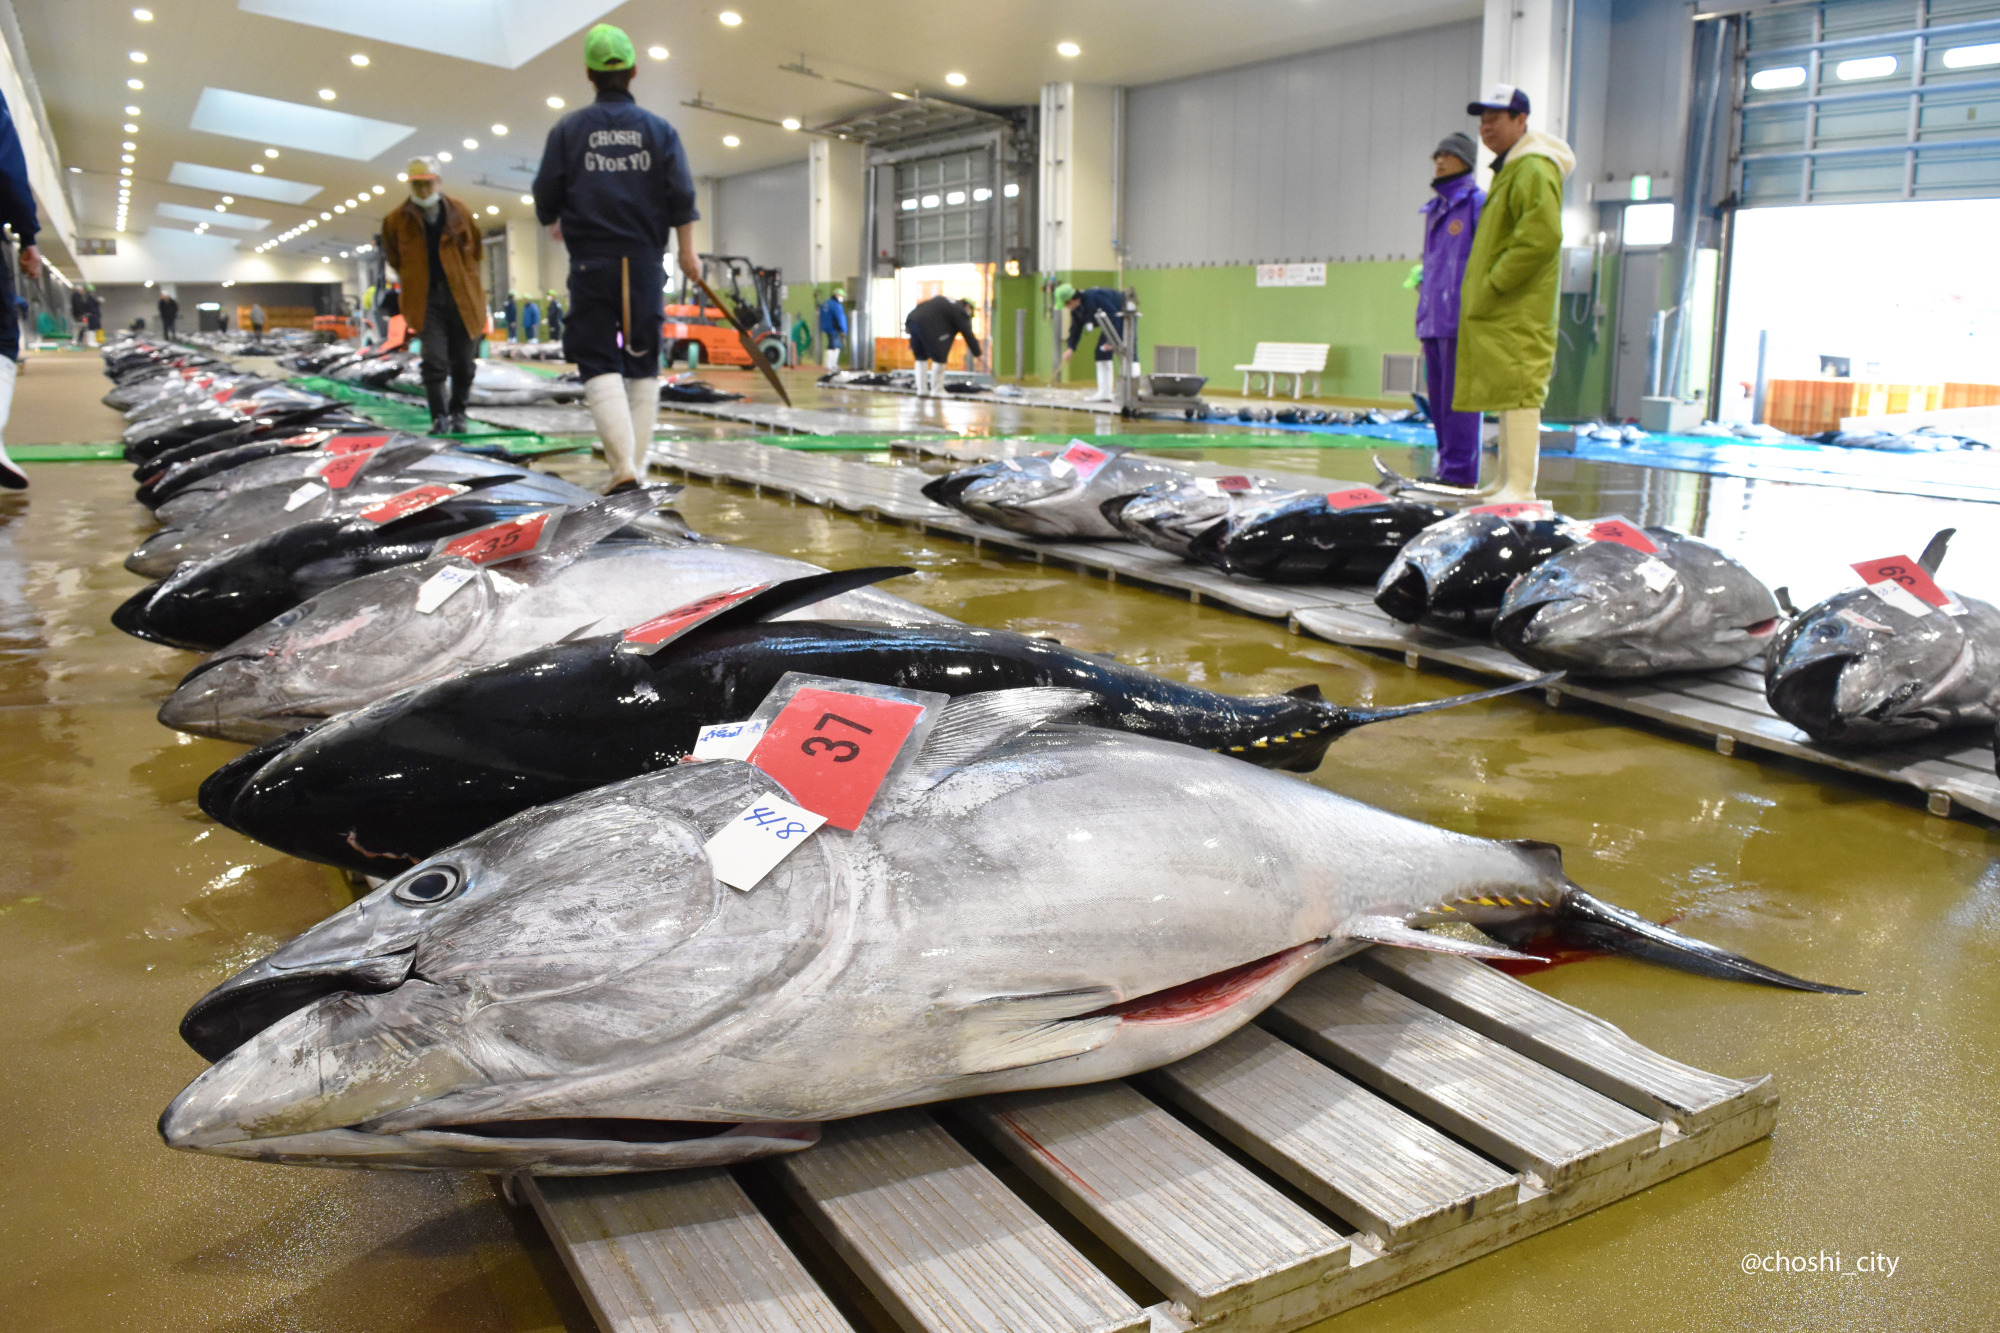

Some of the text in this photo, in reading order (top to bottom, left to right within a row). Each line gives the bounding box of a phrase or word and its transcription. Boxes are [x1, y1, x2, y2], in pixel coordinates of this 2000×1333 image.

[588, 130, 643, 148] CHOSHI
[584, 150, 651, 172] GYOKYO
[479, 528, 523, 554] 35
[1878, 566, 1916, 586] 39
[801, 712, 873, 763] 37
[743, 807, 808, 840] 41.8
